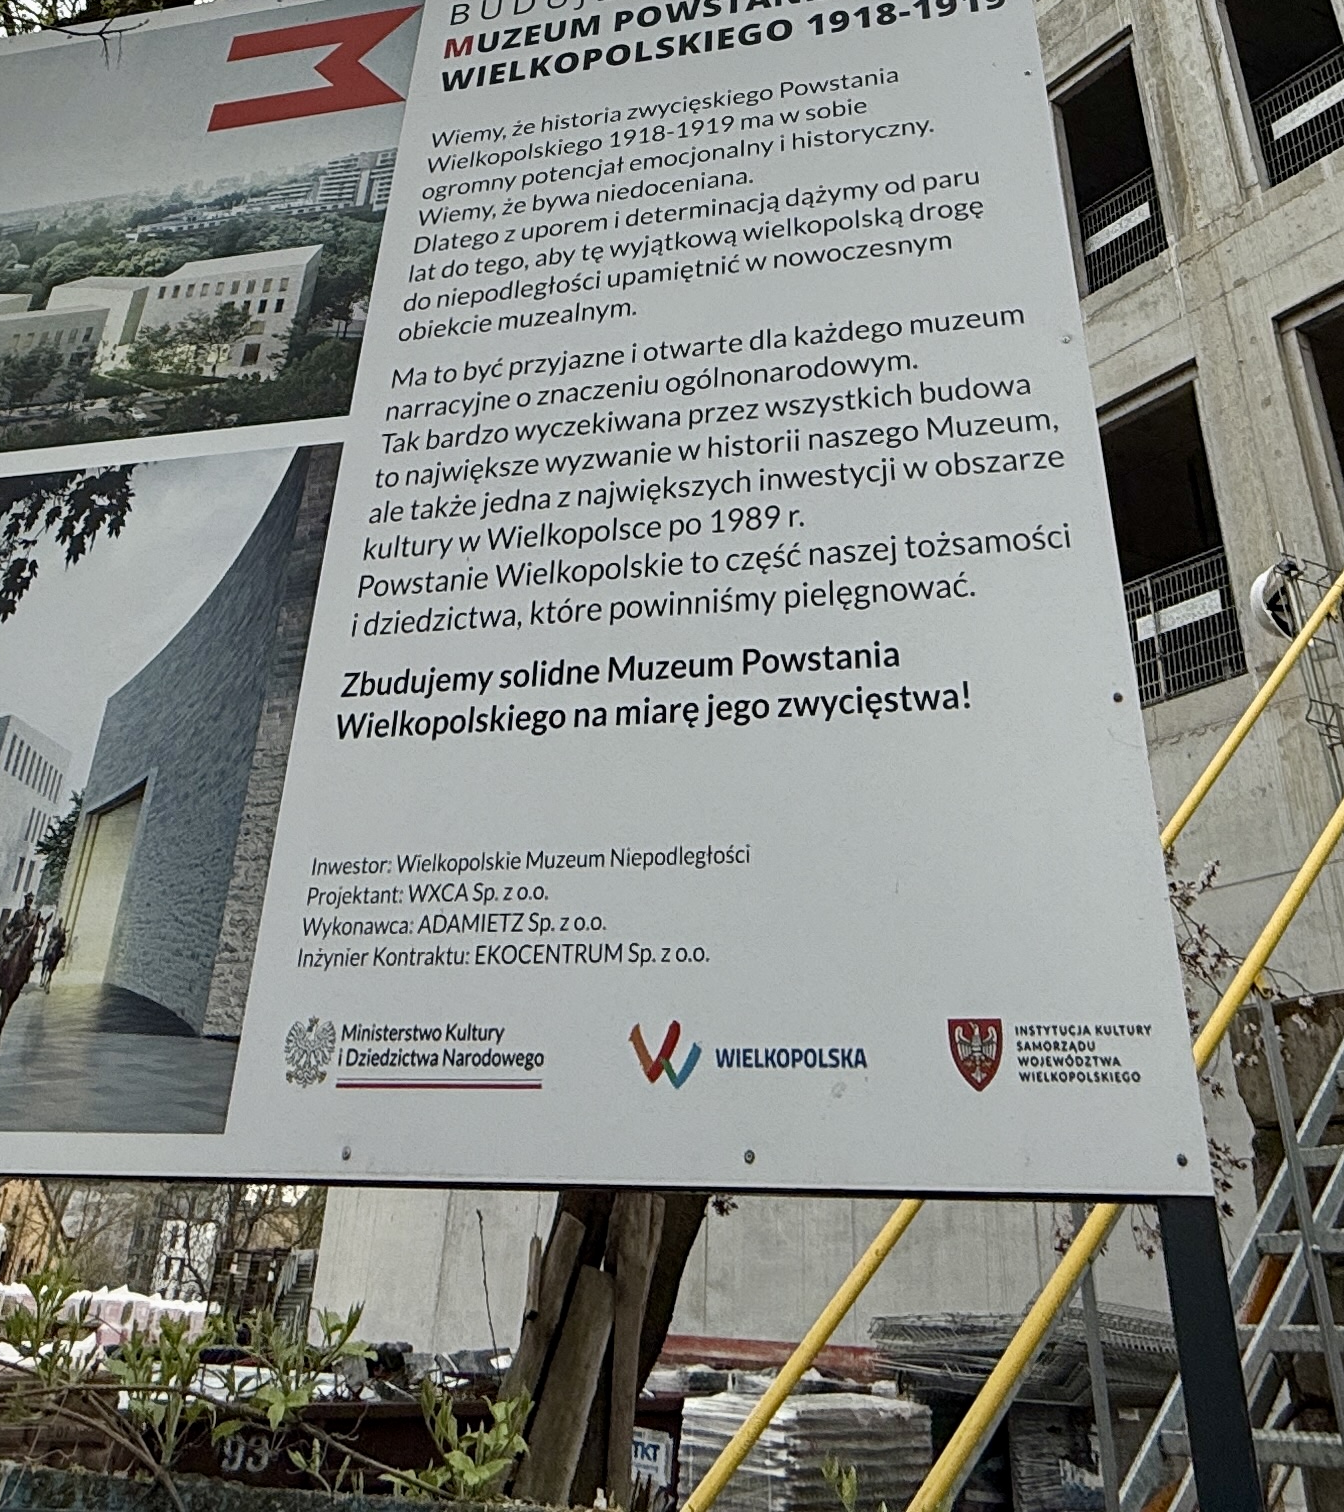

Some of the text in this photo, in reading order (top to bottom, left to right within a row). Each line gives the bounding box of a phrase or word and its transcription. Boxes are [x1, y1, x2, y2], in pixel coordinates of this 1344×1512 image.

[441, 18, 794, 93] WIELKOPOLSKIEGO
[443, 14, 601, 60] MUZEUM
[427, 97, 868, 175] Wielkopolskiego 1918-1919 ma w sobie
[431, 67, 899, 149] Wiemy, że historia zwycięskiego Powstania
[421, 119, 935, 203] ogromny potencjał emocjonalny i historyczny.
[413, 170, 980, 255] Dlatego z uporem i determinacją dążymy od paru
[418, 171, 754, 227] Wiemy, że bywa niedoceniana.
[407, 200, 984, 284] lat do tego, aby tę wyjątkową wielkopolską drogę
[402, 234, 953, 313] do niepodległości upamiętnić w nowoczesnym
[390, 308, 1025, 390] Ma to być przyjazne i otwarte dla każdego muzeum
[398, 300, 637, 343] obiekcie muzealnym.
[381, 376, 1032, 455] Tak bardzo wyczekiwana przez wszystkich budowa
[385, 354, 920, 423] narracyjne o znaczeniu ogólnonarodowym.
[375, 413, 1060, 490] to największe wyzwanie w historii naszego Muzeum,
[368, 449, 1066, 525] ale także jedna z największych inwestycji w obszarze
[357, 522, 1072, 599] Powstanie Wielkopolskie to część naszej tożsamości
[362, 504, 805, 562] kultury w Wielkopolsce po 1989 r.
[351, 570, 976, 639] i dziedzictwa, które powinniśmy pielęgnować.
[339, 639, 901, 700] Zbudujemy solidne Muzeum Powstania
[336, 680, 971, 742] Wielkopolskiego na miarę jego zwycięstwa!
[311, 843, 752, 877] Inwestor: Wielkopolskie Muzeum Niepodległości
[302, 911, 608, 942] Wykonawca: ADAMIETZ Sp. z o.o.
[306, 881, 549, 911] Projektant: WXCA Sp. z o.o.
[297, 942, 711, 973] Inżynier Kontraktu: EKOCENTRUM Sp. z o.o.
[337, 1046, 545, 1072] i Dziedzictwa Narodowego
[340, 1022, 506, 1046] Ministerstwo Kultury
[714, 1047, 869, 1070] WIELKOPOLSKA
[1014, 1023, 1153, 1039] INSTYTUCJA KULTURY
[1015, 1039, 1097, 1055] SAMORZĄDU
[1016, 1053, 1123, 1069] WOJEWÓDZTWA
[1017, 1070, 1142, 1085] WIELKOPOLSKIEGO
